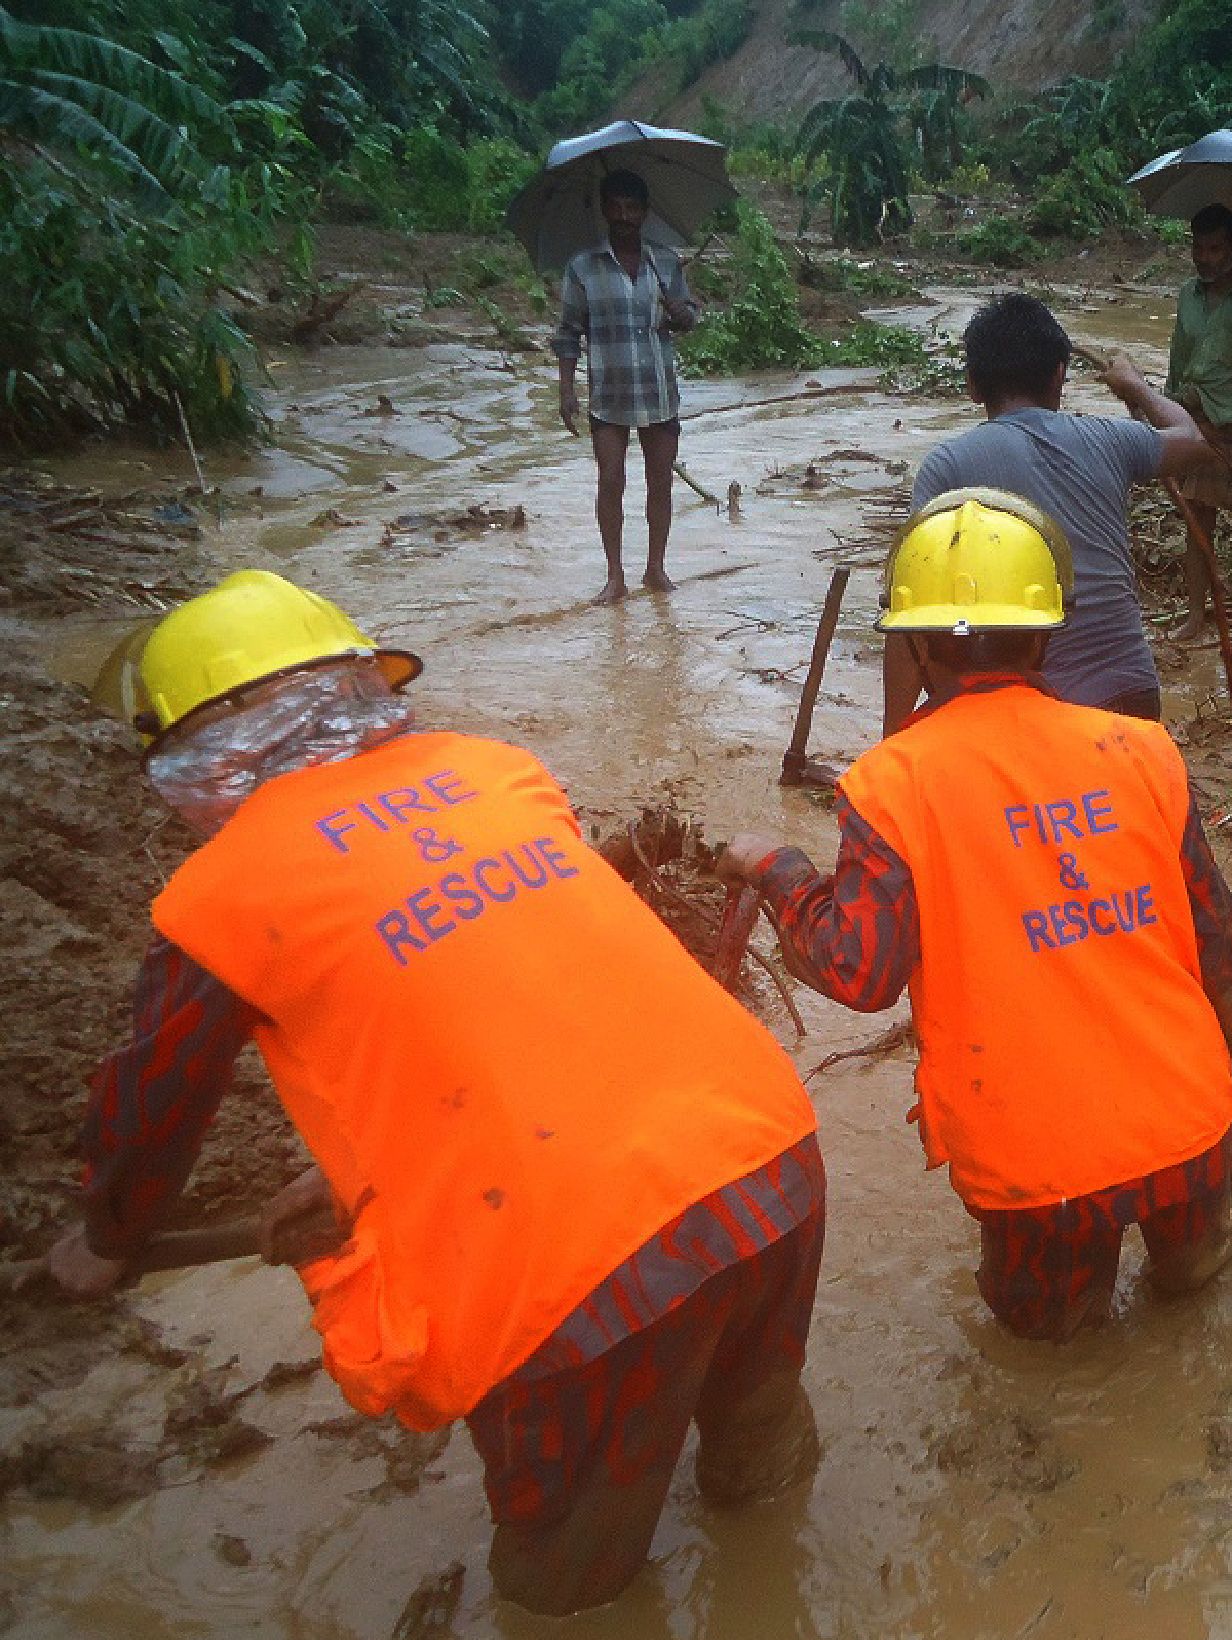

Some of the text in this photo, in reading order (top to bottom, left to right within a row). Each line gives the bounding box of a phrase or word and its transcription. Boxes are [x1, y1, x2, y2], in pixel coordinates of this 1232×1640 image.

[316, 770, 479, 853] FIRE
[1004, 789, 1119, 848] FIRE
[411, 827, 464, 862] &
[1058, 852, 1089, 890] &
[376, 837, 579, 966] RESCUE
[1022, 882, 1157, 952] RESCUE
